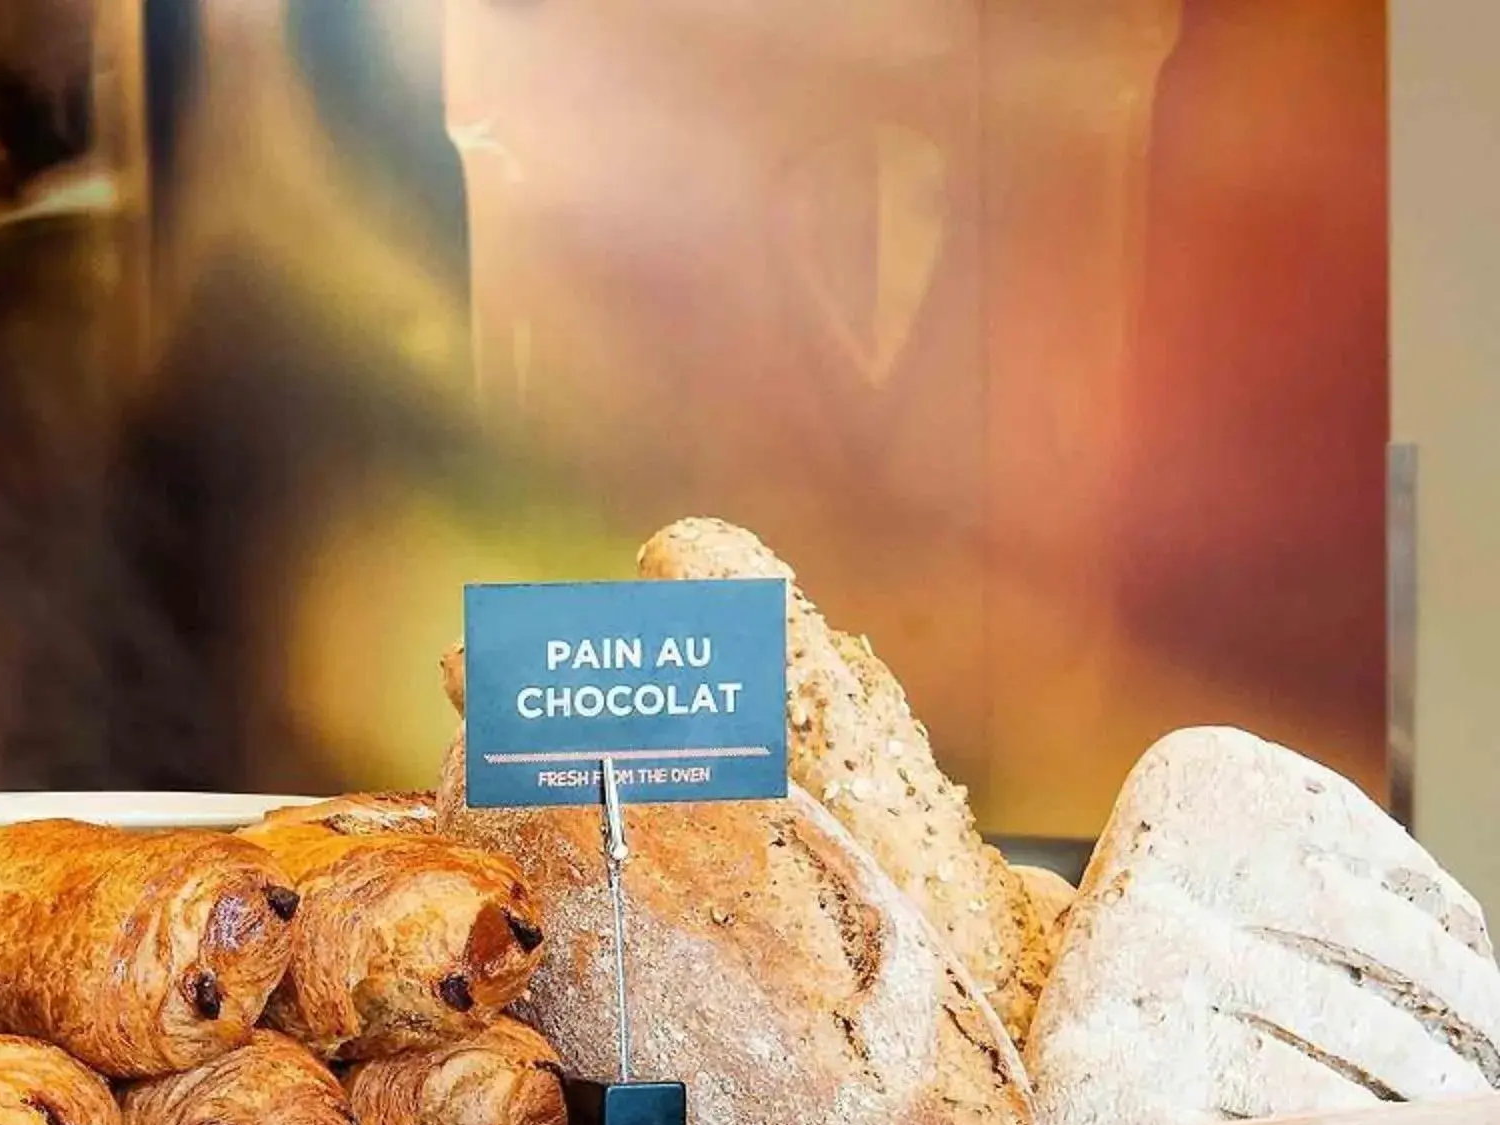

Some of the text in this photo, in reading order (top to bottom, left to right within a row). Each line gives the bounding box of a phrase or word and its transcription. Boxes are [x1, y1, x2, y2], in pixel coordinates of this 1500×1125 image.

[547, 637, 711, 671] PAIN AU
[517, 682, 742, 719] CHOCOLAT
[537, 765, 711, 788] FRESH FOM THE OVEN
